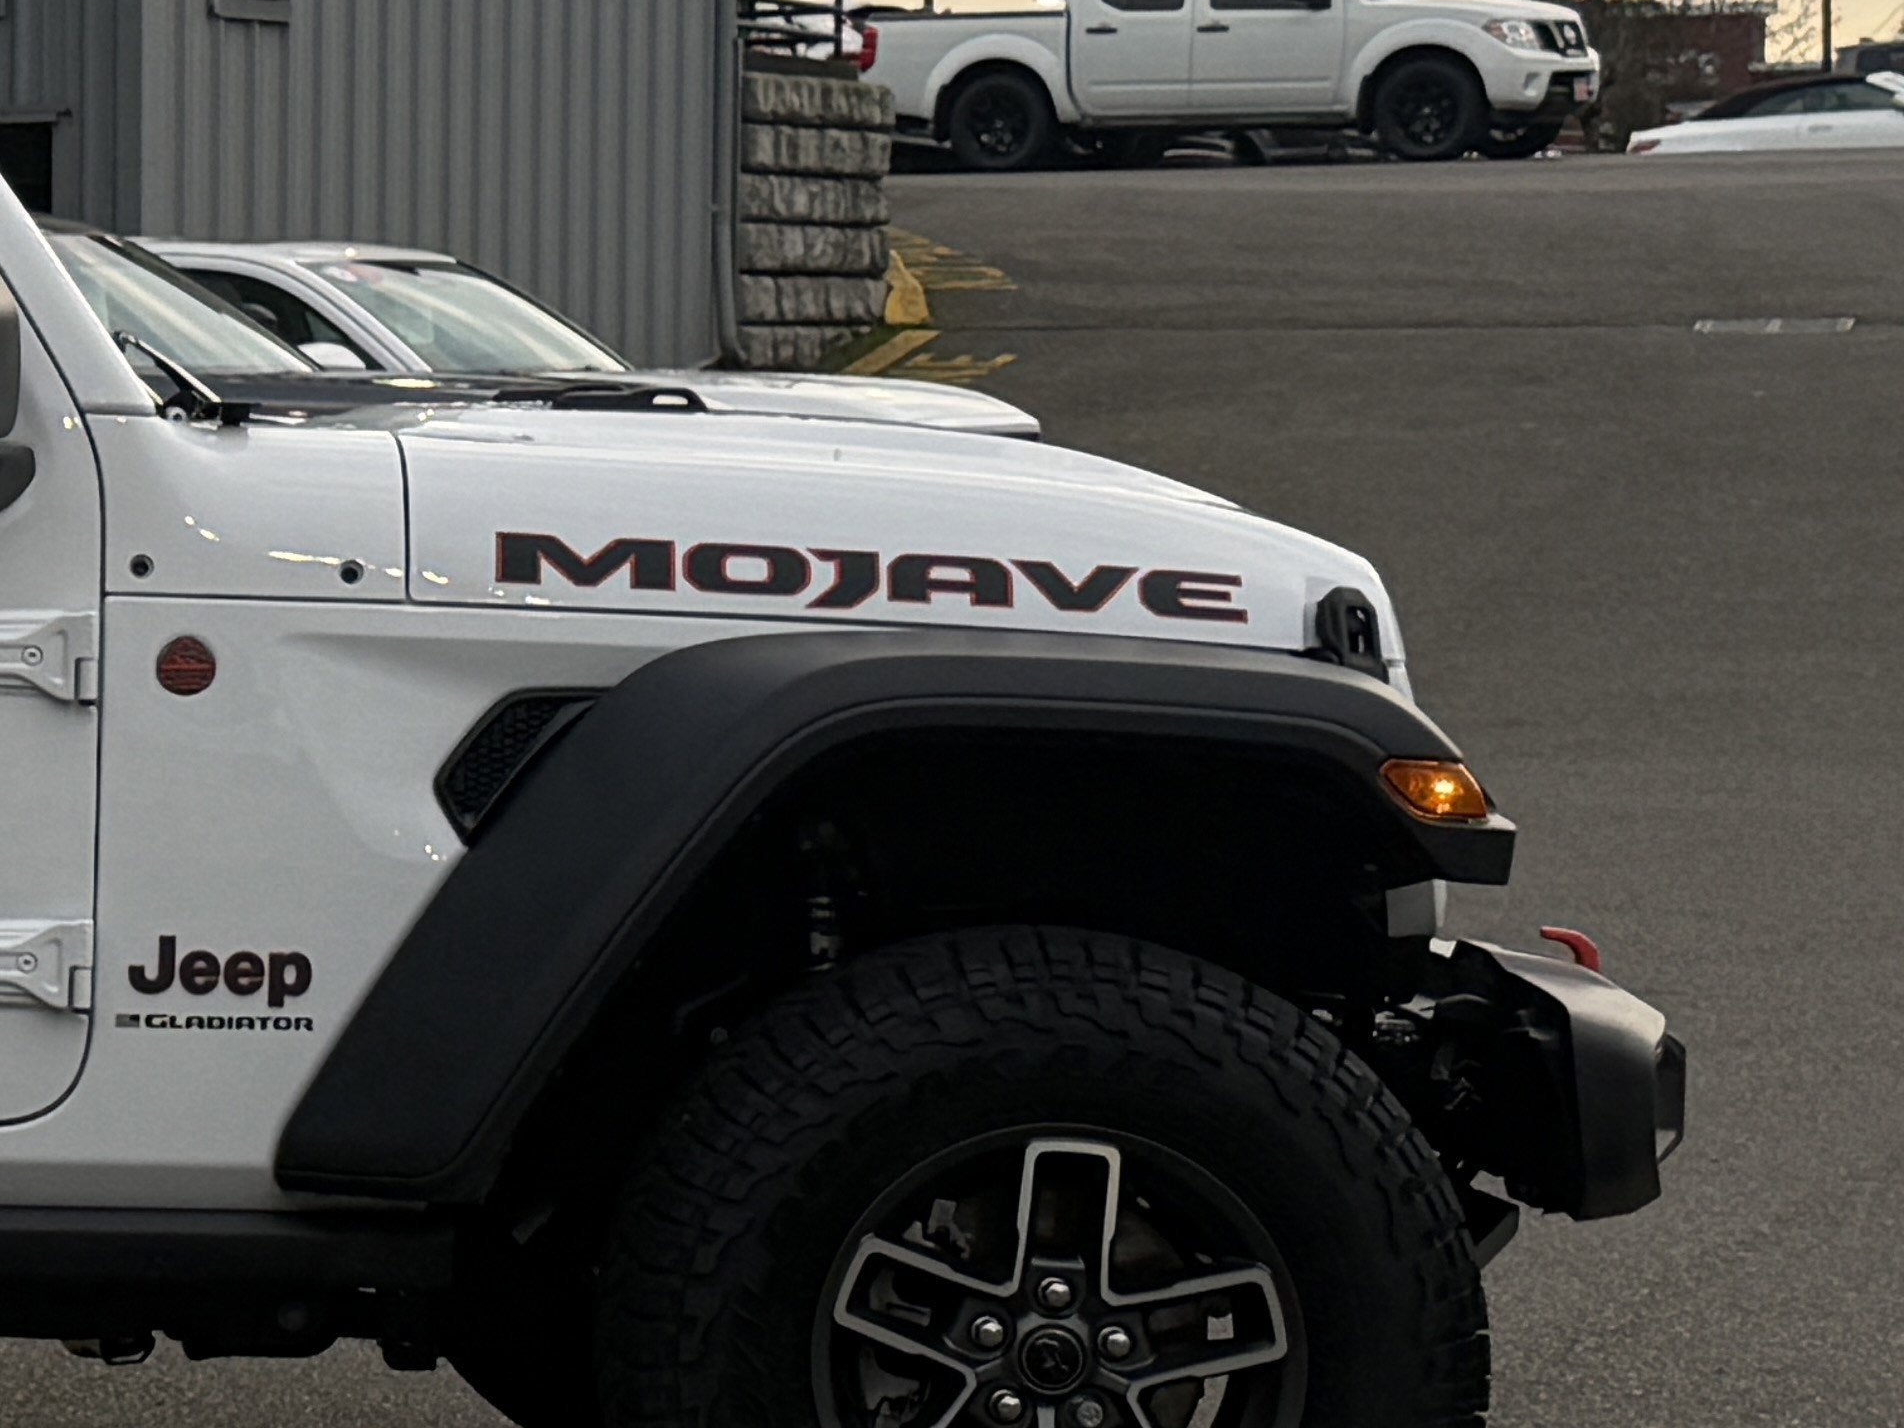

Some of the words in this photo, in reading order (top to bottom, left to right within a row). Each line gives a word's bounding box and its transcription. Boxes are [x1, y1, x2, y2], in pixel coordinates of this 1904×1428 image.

[495, 530, 1249, 624] MOJAVE
[128, 935, 312, 1008] Jeep
[145, 1013, 313, 1032] GLADIATOR
